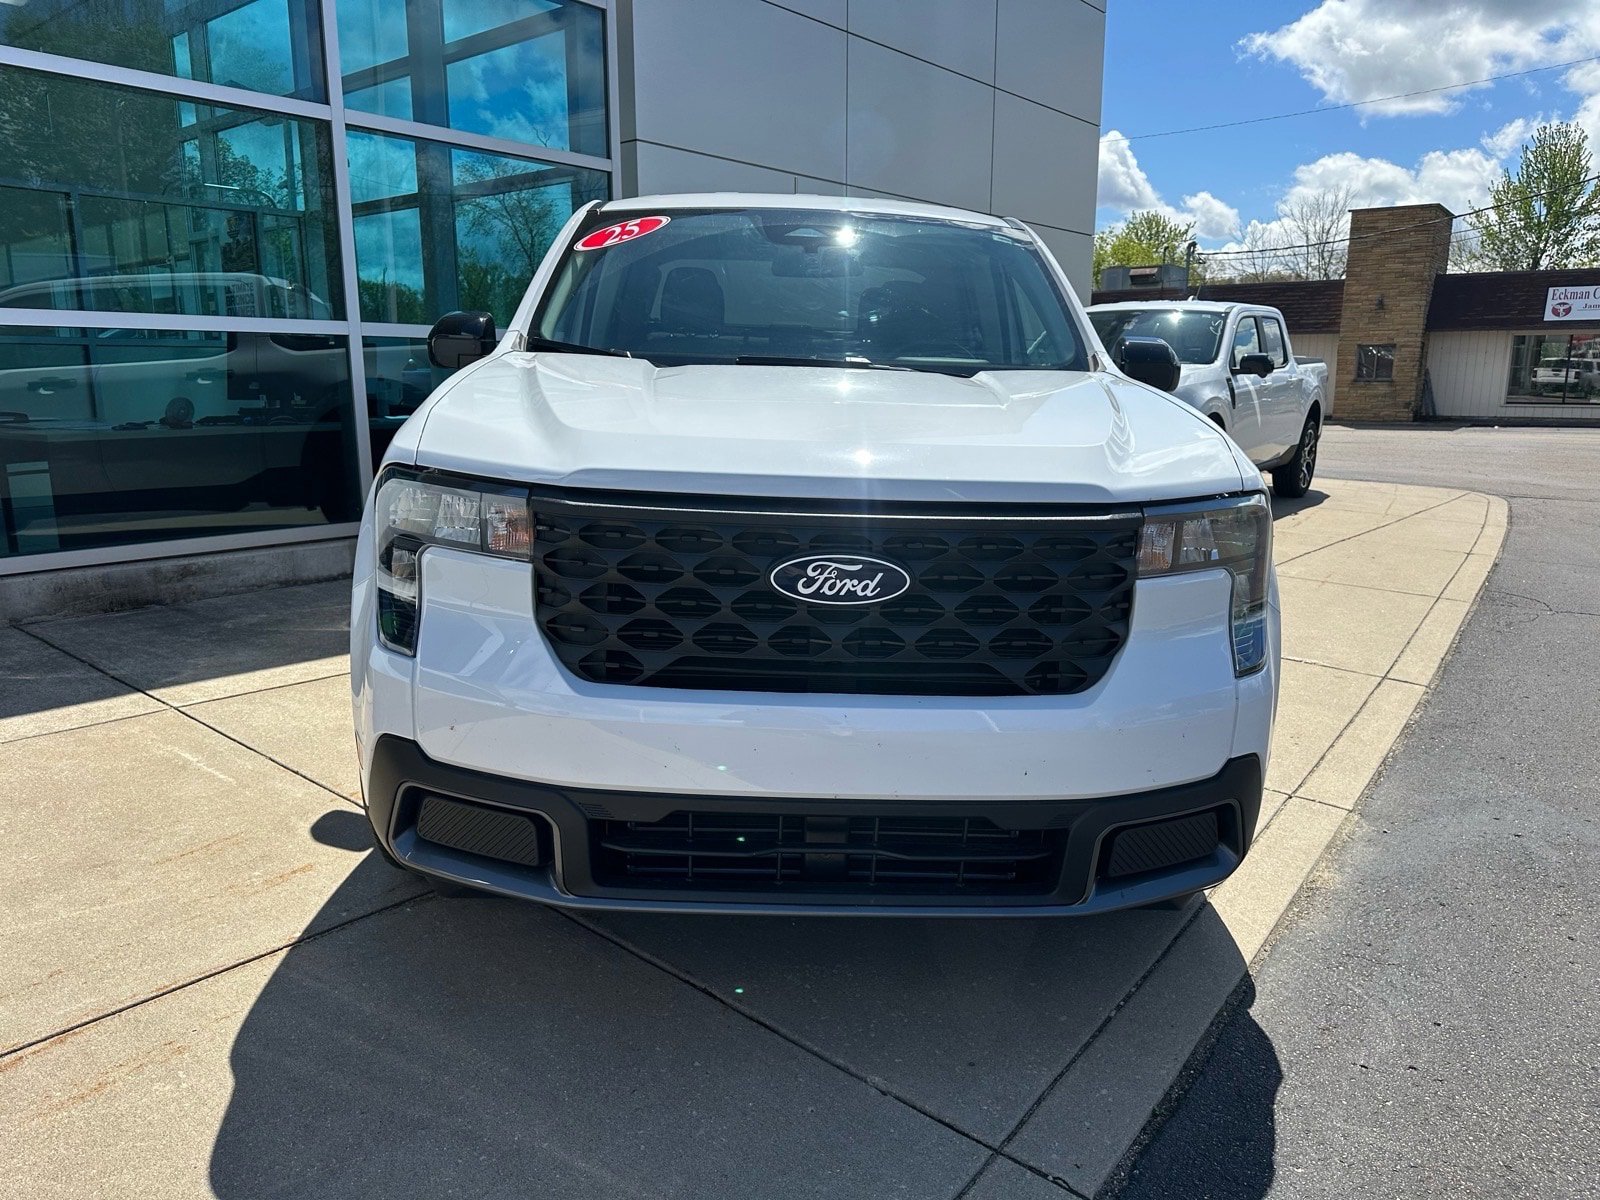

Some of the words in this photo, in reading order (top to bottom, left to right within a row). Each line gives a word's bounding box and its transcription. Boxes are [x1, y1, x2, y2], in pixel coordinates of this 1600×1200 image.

[603, 219, 641, 247] 25
[1551, 288, 1590, 301] Eckman
[797, 561, 884, 597] Ford
